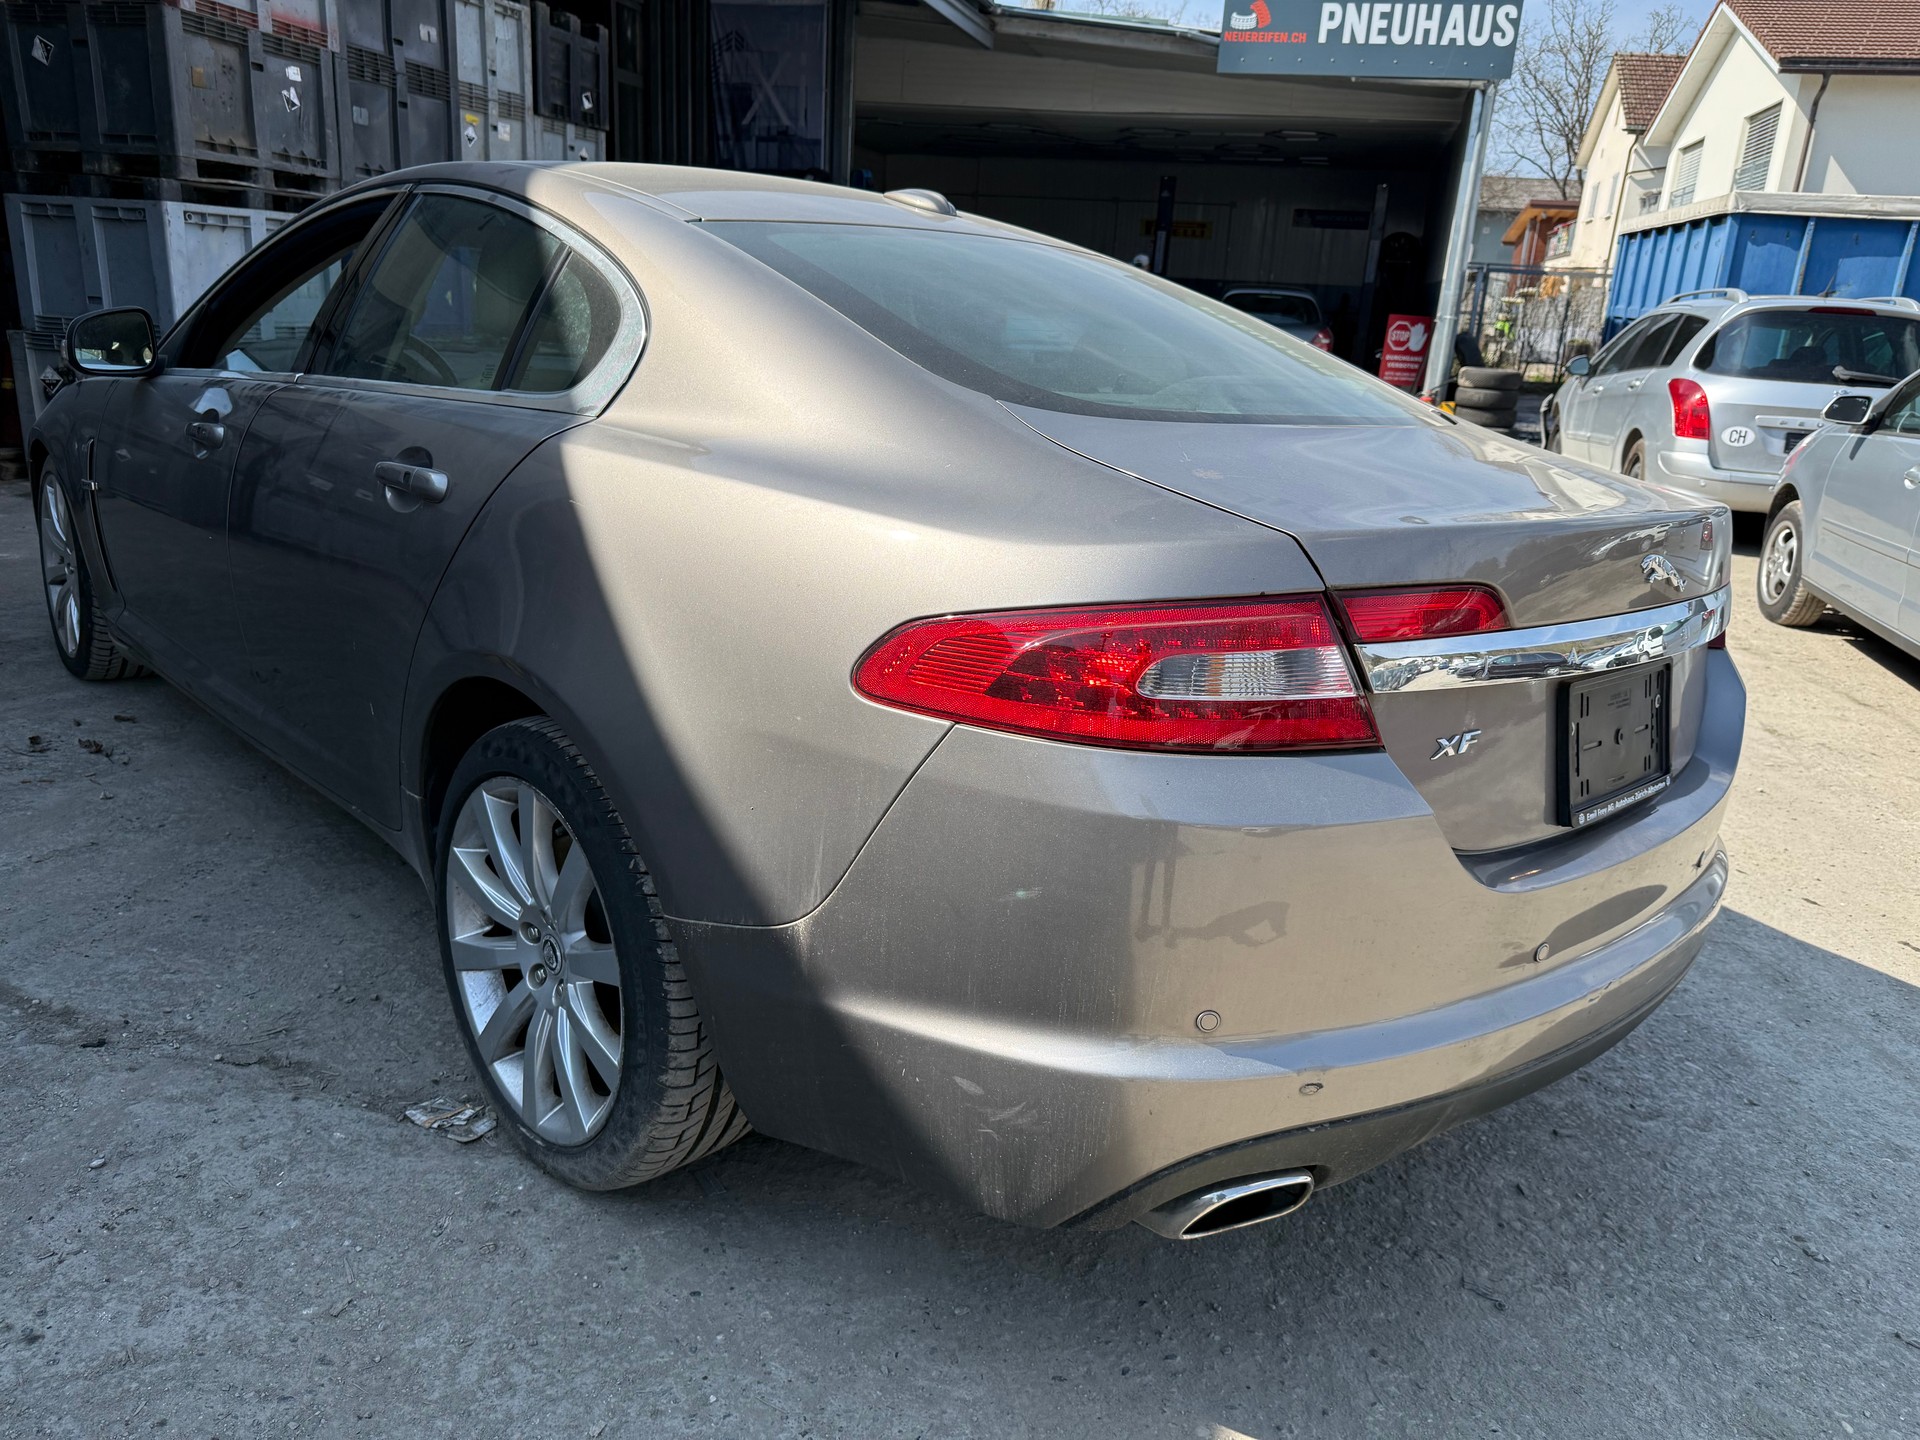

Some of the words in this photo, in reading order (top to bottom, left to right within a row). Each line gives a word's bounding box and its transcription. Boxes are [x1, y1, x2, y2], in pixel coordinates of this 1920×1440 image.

[1318, 2, 1518, 47] PNEUHAUS
[1224, 31, 1307, 43] NEUEREIFEN.CH
[1391, 330, 1410, 341] STOP
[1729, 429, 1747, 444] CH
[1430, 729, 1481, 760] XF
